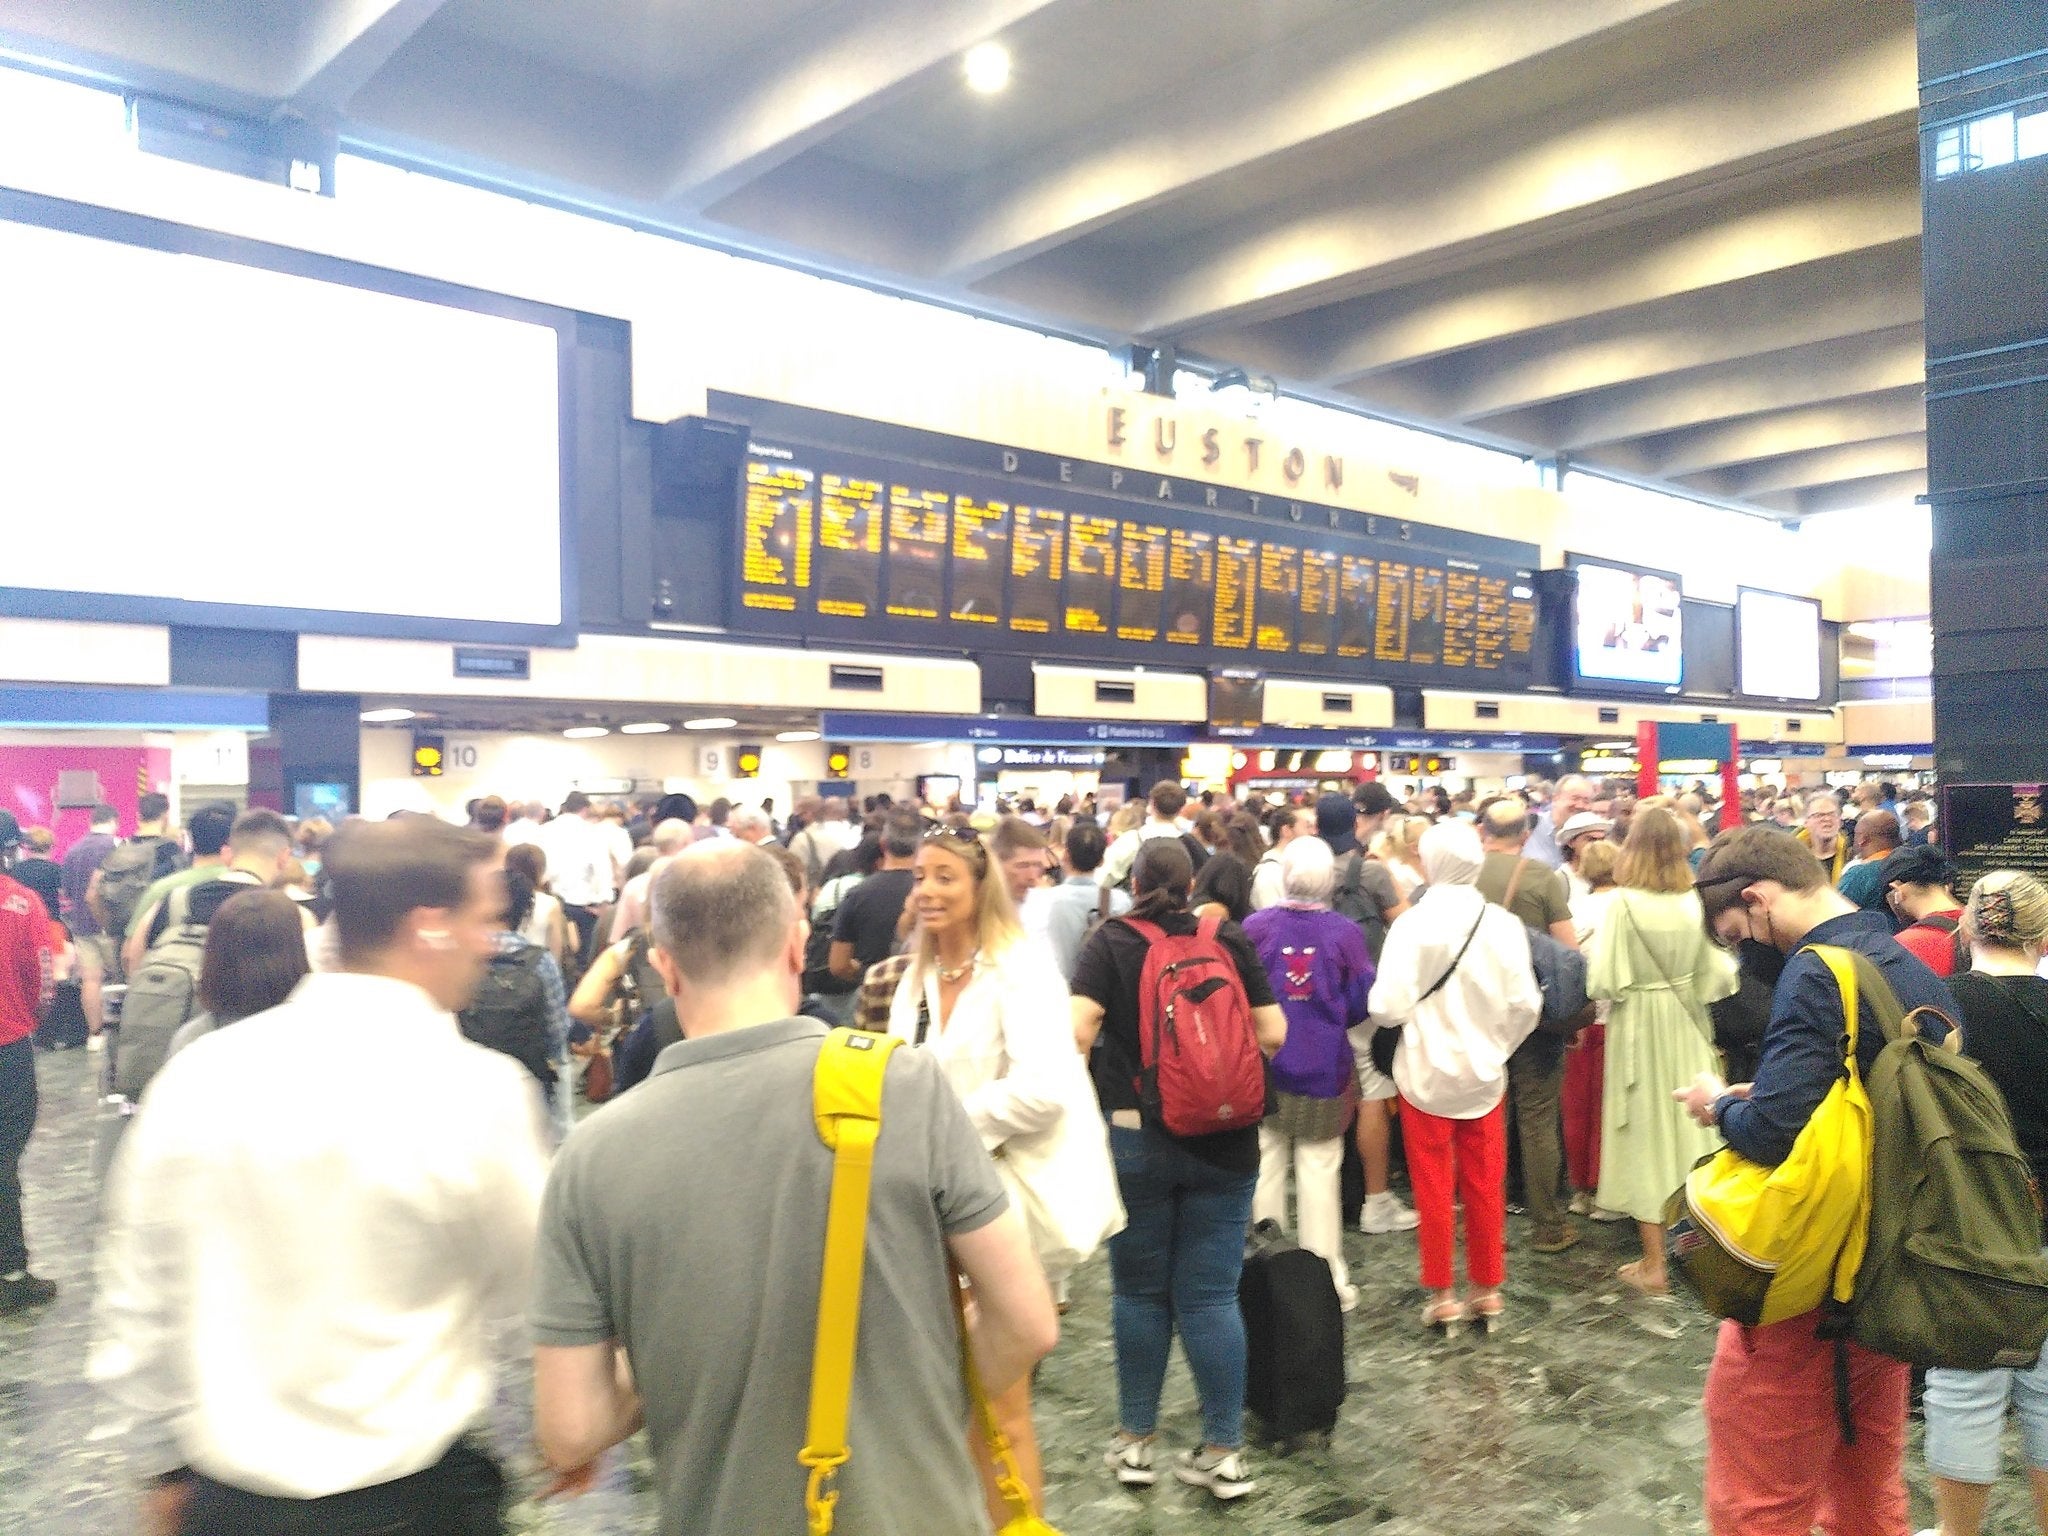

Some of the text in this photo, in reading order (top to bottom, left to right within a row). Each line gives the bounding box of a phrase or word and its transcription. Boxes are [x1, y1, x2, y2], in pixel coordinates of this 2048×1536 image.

[1106, 406, 1343, 489] EUSTON
[1003, 450, 1411, 543] DEPARTURES
[452, 745, 477, 767] 10
[706, 752, 719, 770] 9
[860, 751, 872, 769] 8
